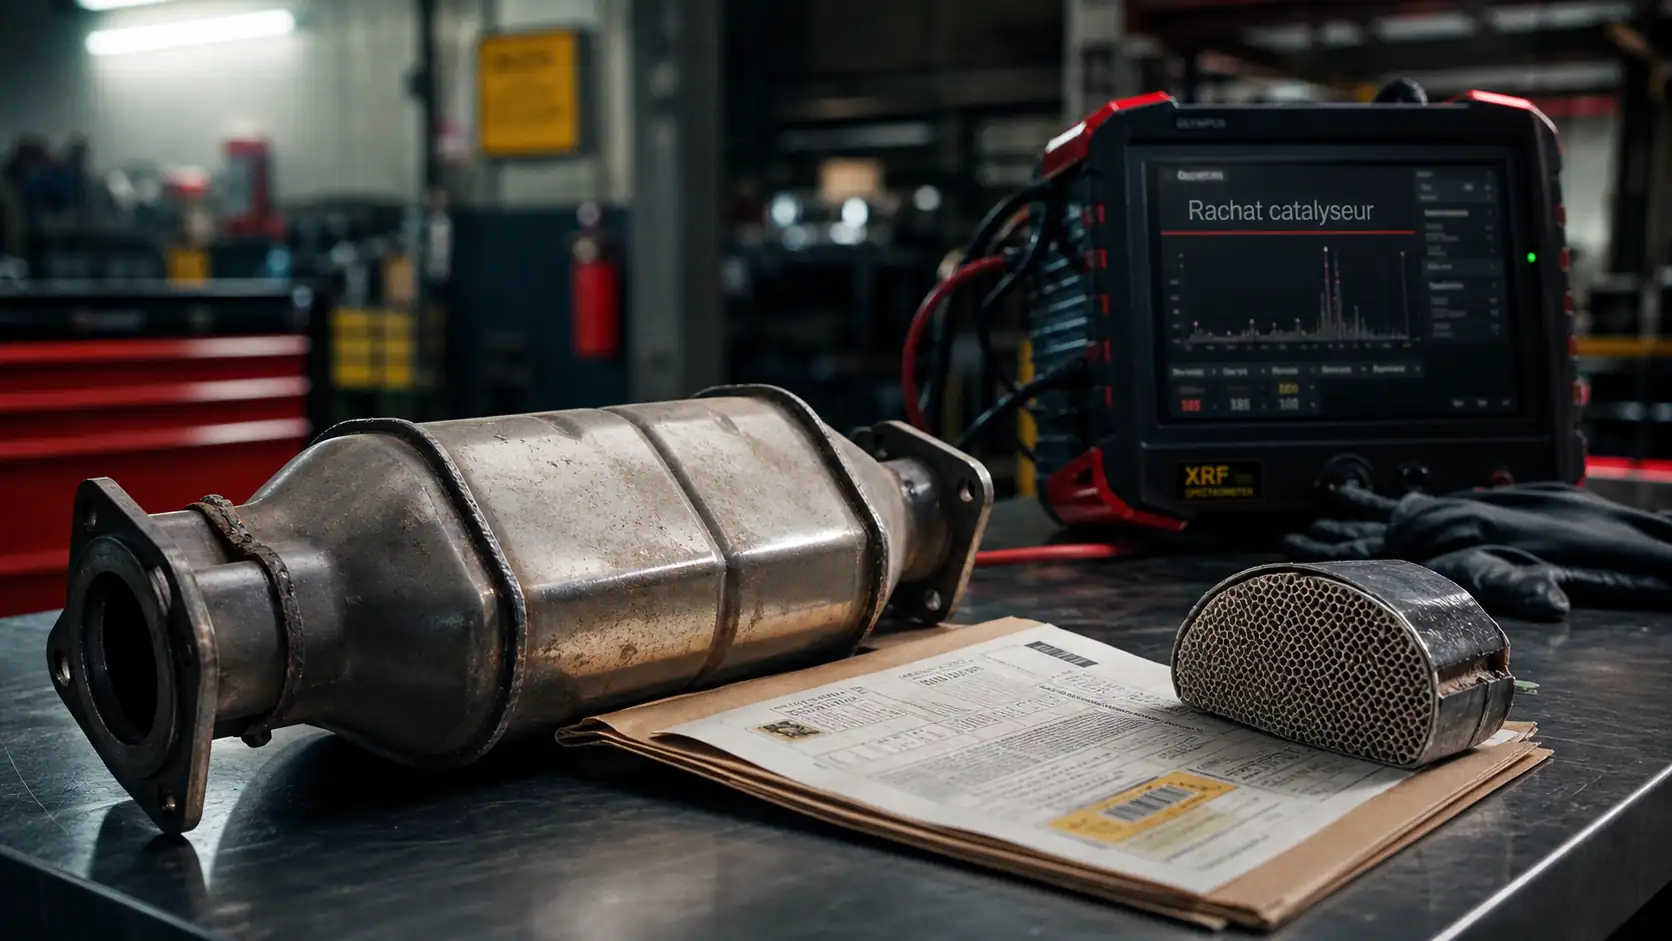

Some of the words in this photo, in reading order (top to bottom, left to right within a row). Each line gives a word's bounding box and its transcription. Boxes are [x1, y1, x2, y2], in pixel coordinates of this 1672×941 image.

[1188, 198, 1264, 221] Rachat
[1269, 198, 1375, 226] catalyseur
[1184, 465, 1230, 486] XRF
